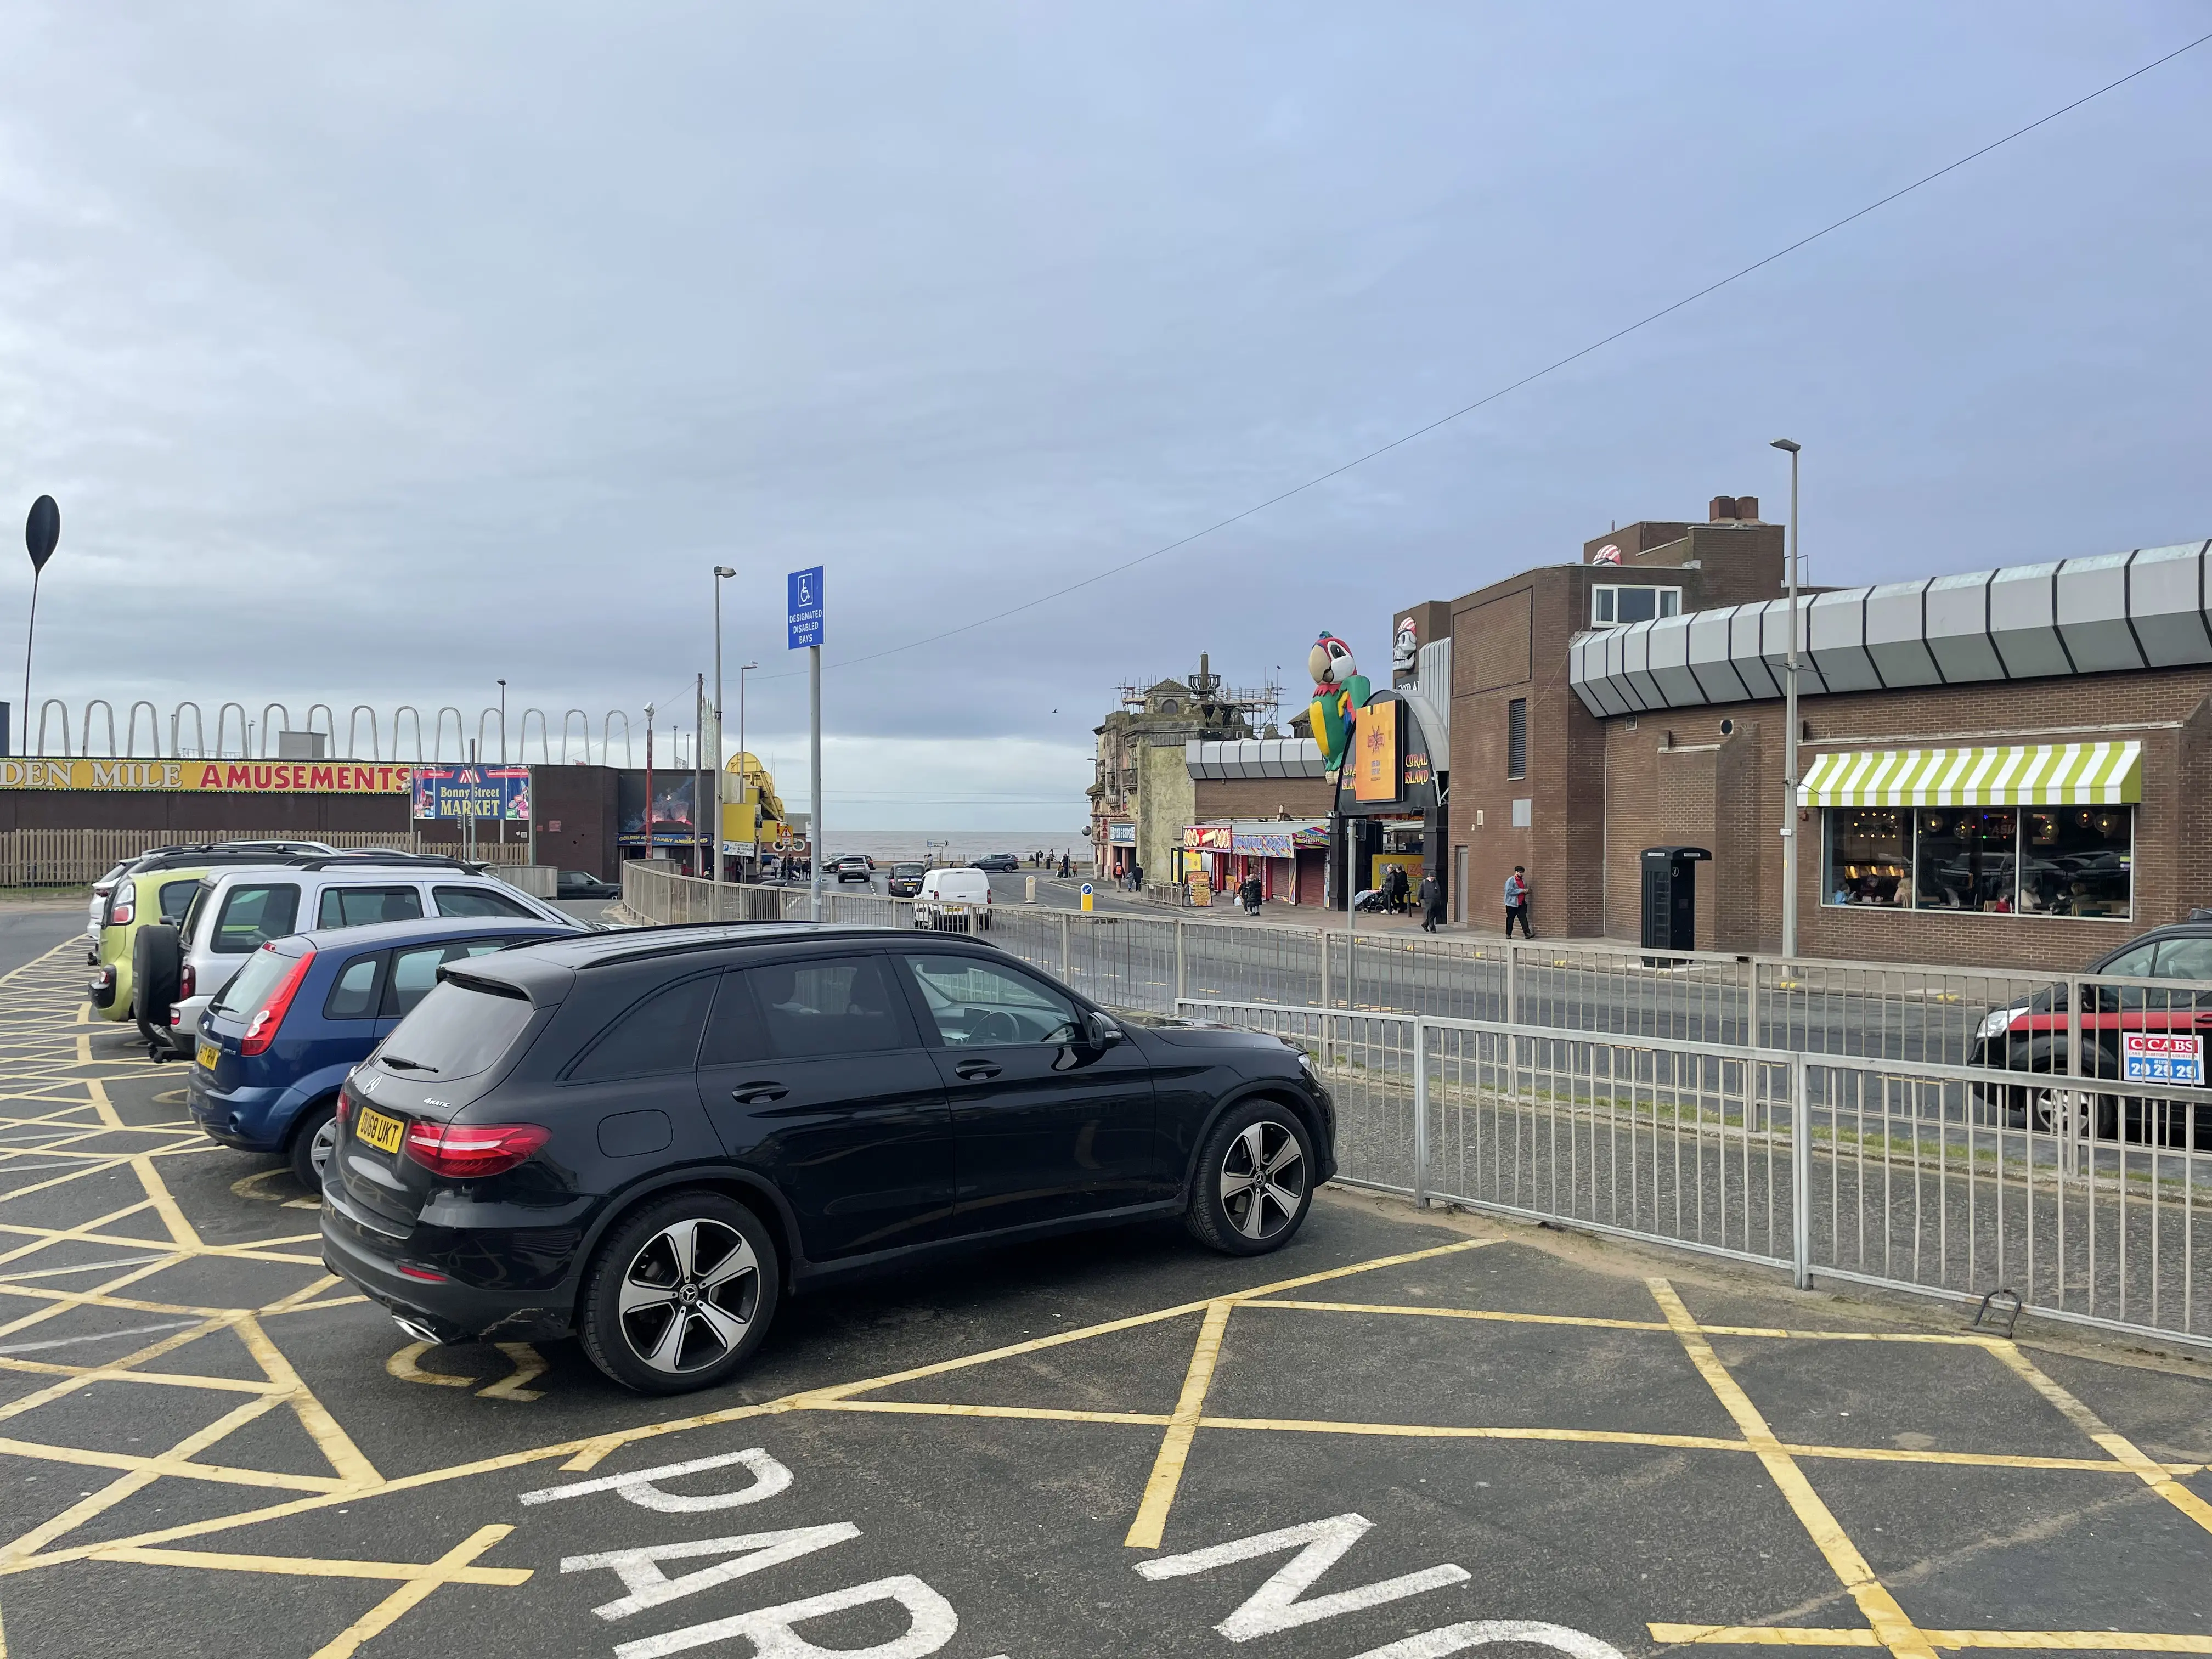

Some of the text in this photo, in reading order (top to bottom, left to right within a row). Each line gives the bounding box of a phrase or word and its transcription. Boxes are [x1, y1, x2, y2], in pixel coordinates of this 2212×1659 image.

[789, 610, 822, 623] DESIGNATED
[793, 622, 819, 634] DISABLED
[799, 634, 812, 644] BAYS
[1406, 753, 1428, 768] CORAL
[91, 762, 183, 788] MILE
[200, 765, 410, 791] AMUSEMENTS
[1405, 770, 1429, 785] ISLAND
[441, 787, 470, 799] Bonny
[441, 800, 500, 816] MARKET
[424, 1098, 450, 1108] 4MATIC
[377, 1120, 399, 1147] UKT
